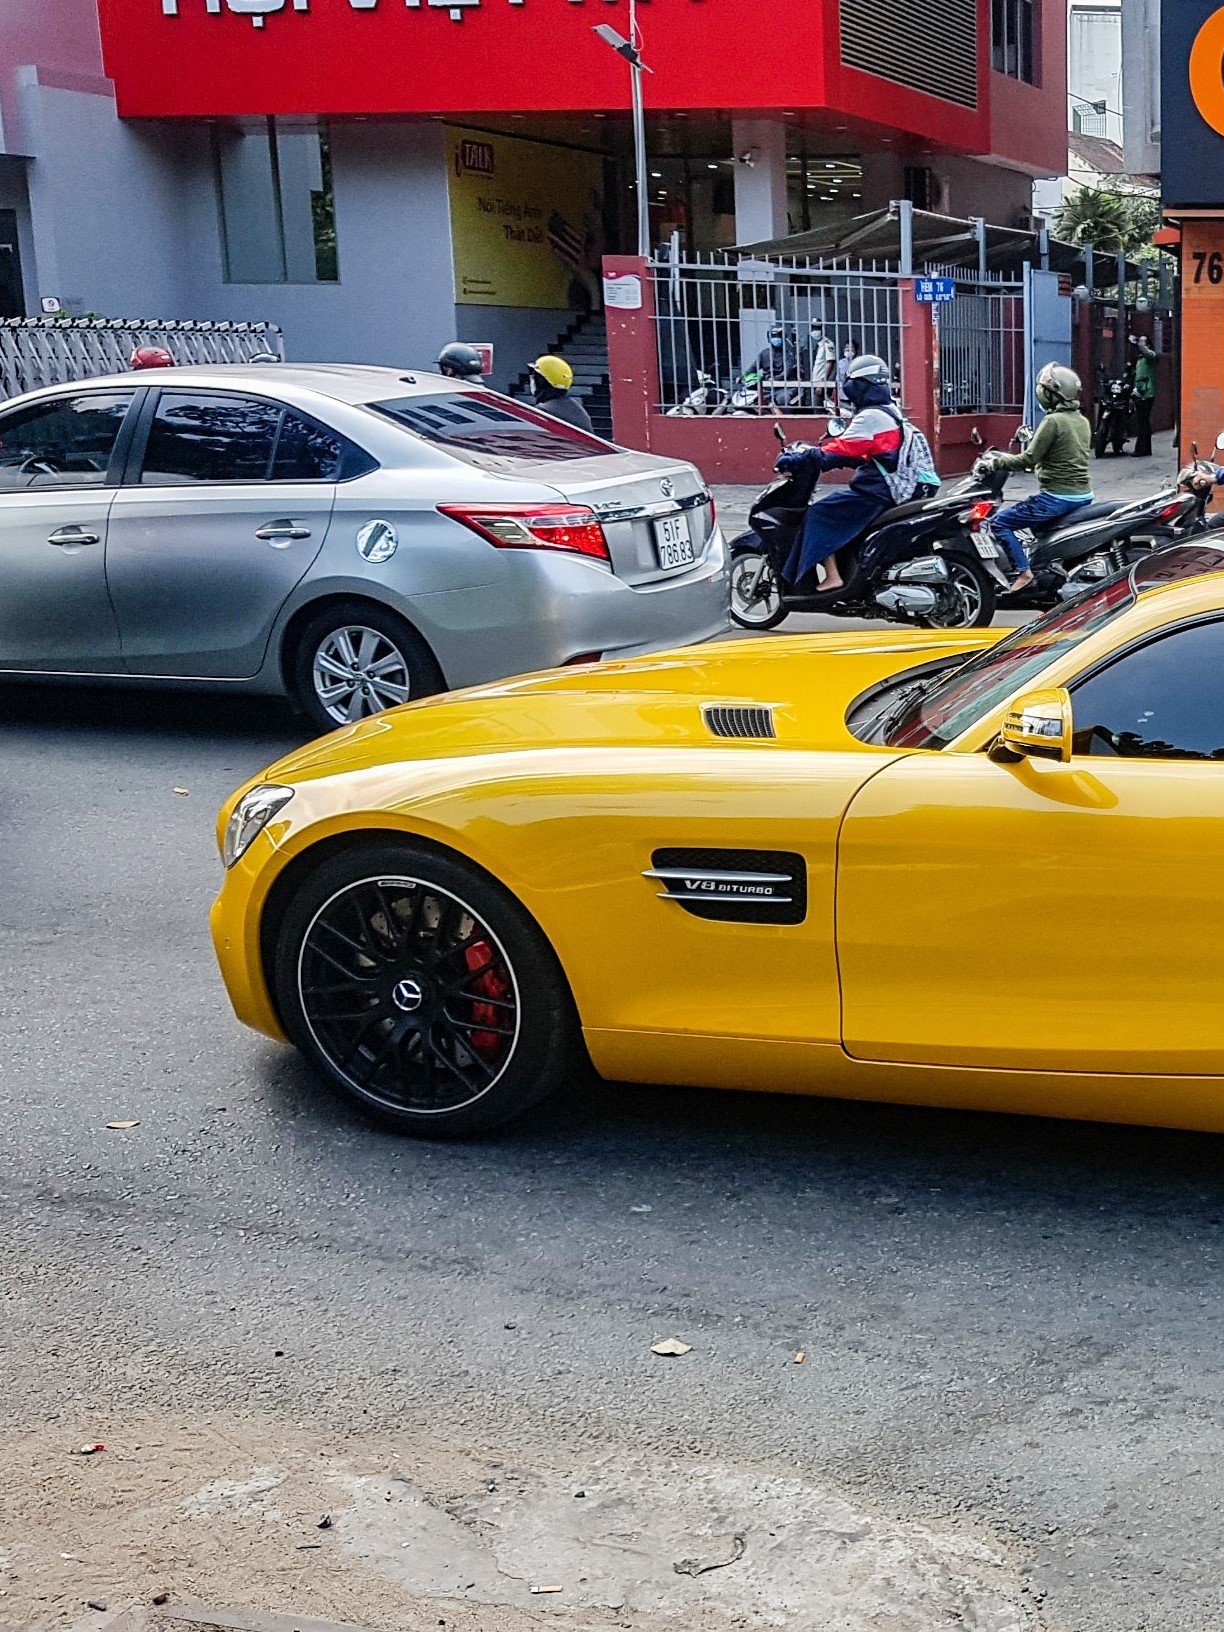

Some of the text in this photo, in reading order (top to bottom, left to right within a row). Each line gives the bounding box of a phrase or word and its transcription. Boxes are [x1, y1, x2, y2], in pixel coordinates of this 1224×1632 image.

[1192, 251, 1223, 285] 76
[663, 519, 680, 542] 51F
[684, 879, 774, 895] V8 BITURBO
